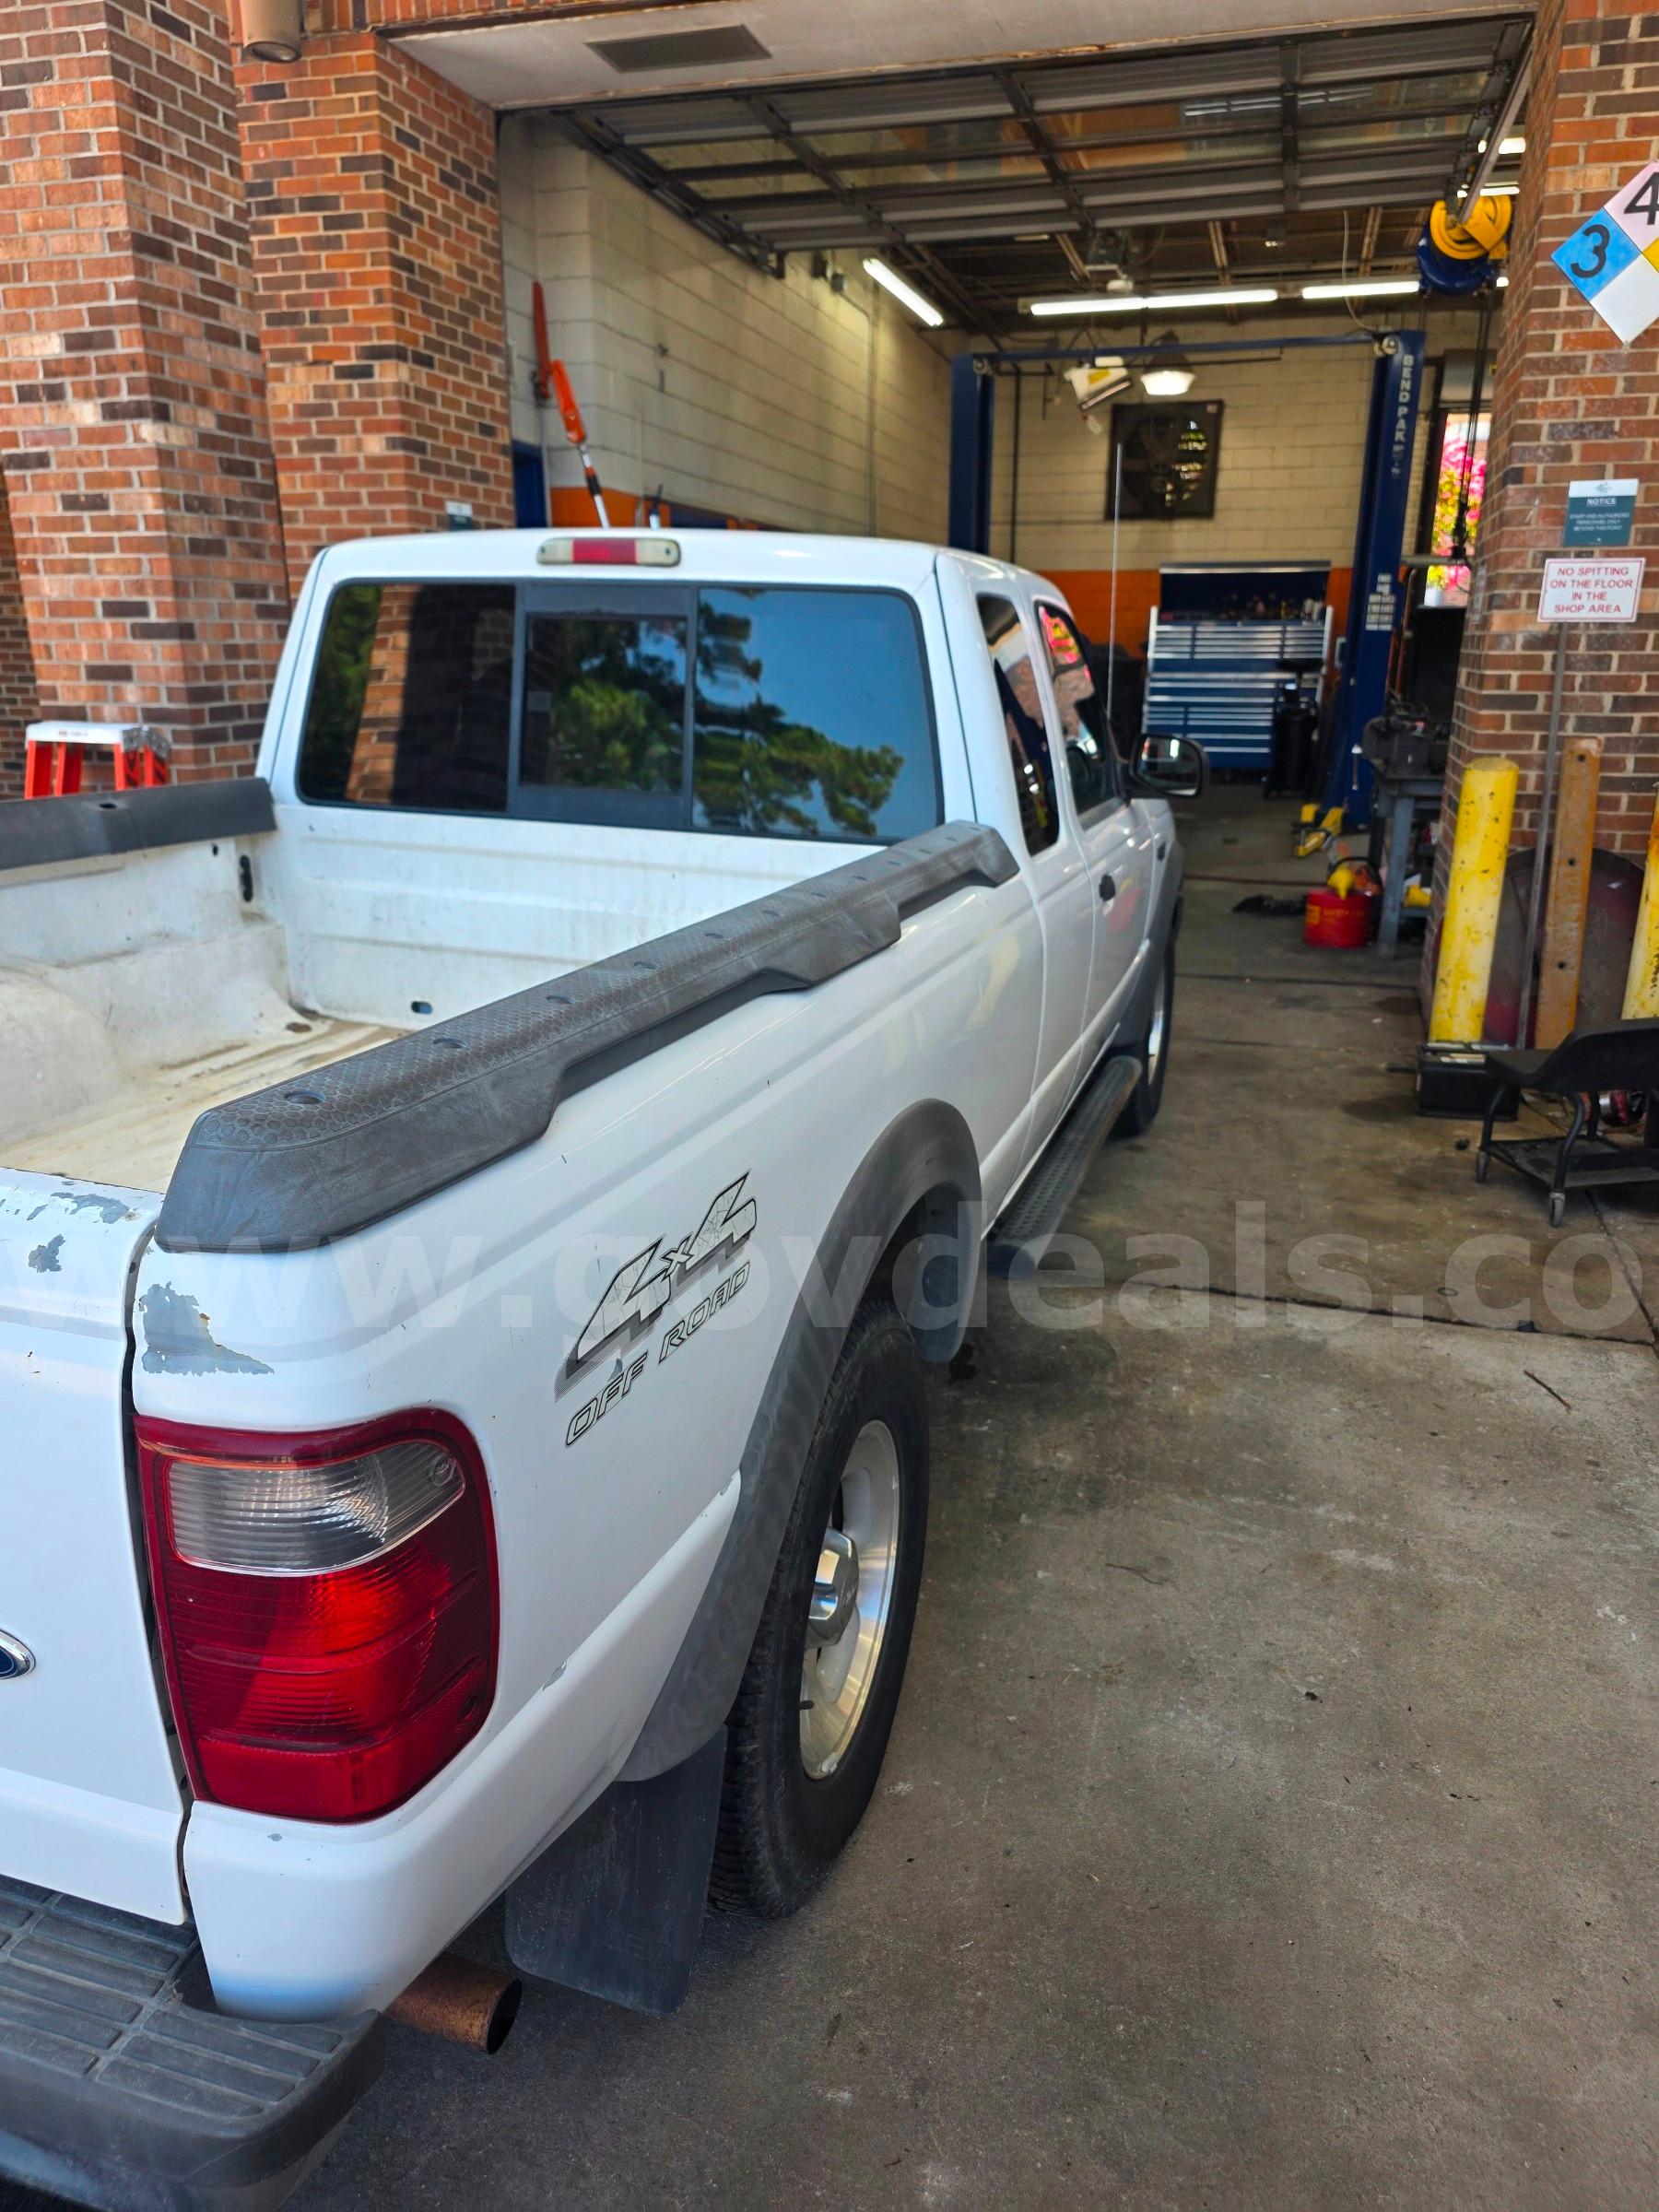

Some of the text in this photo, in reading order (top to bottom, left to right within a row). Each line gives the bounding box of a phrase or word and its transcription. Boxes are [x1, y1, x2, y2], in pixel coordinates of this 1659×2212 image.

[1623, 171, 1659, 226] 4
[1571, 224, 1610, 278] 3
[1587, 498, 1617, 506] NOTICE
[1558, 567, 1629, 576] NO SPITTING
[1550, 579, 1633, 589] ON THE FLOOR
[1571, 592, 1607, 601] IN THE
[1554, 604, 1621, 613] SHOP AREA
[565, 1260, 751, 1449] OFF ROAD
